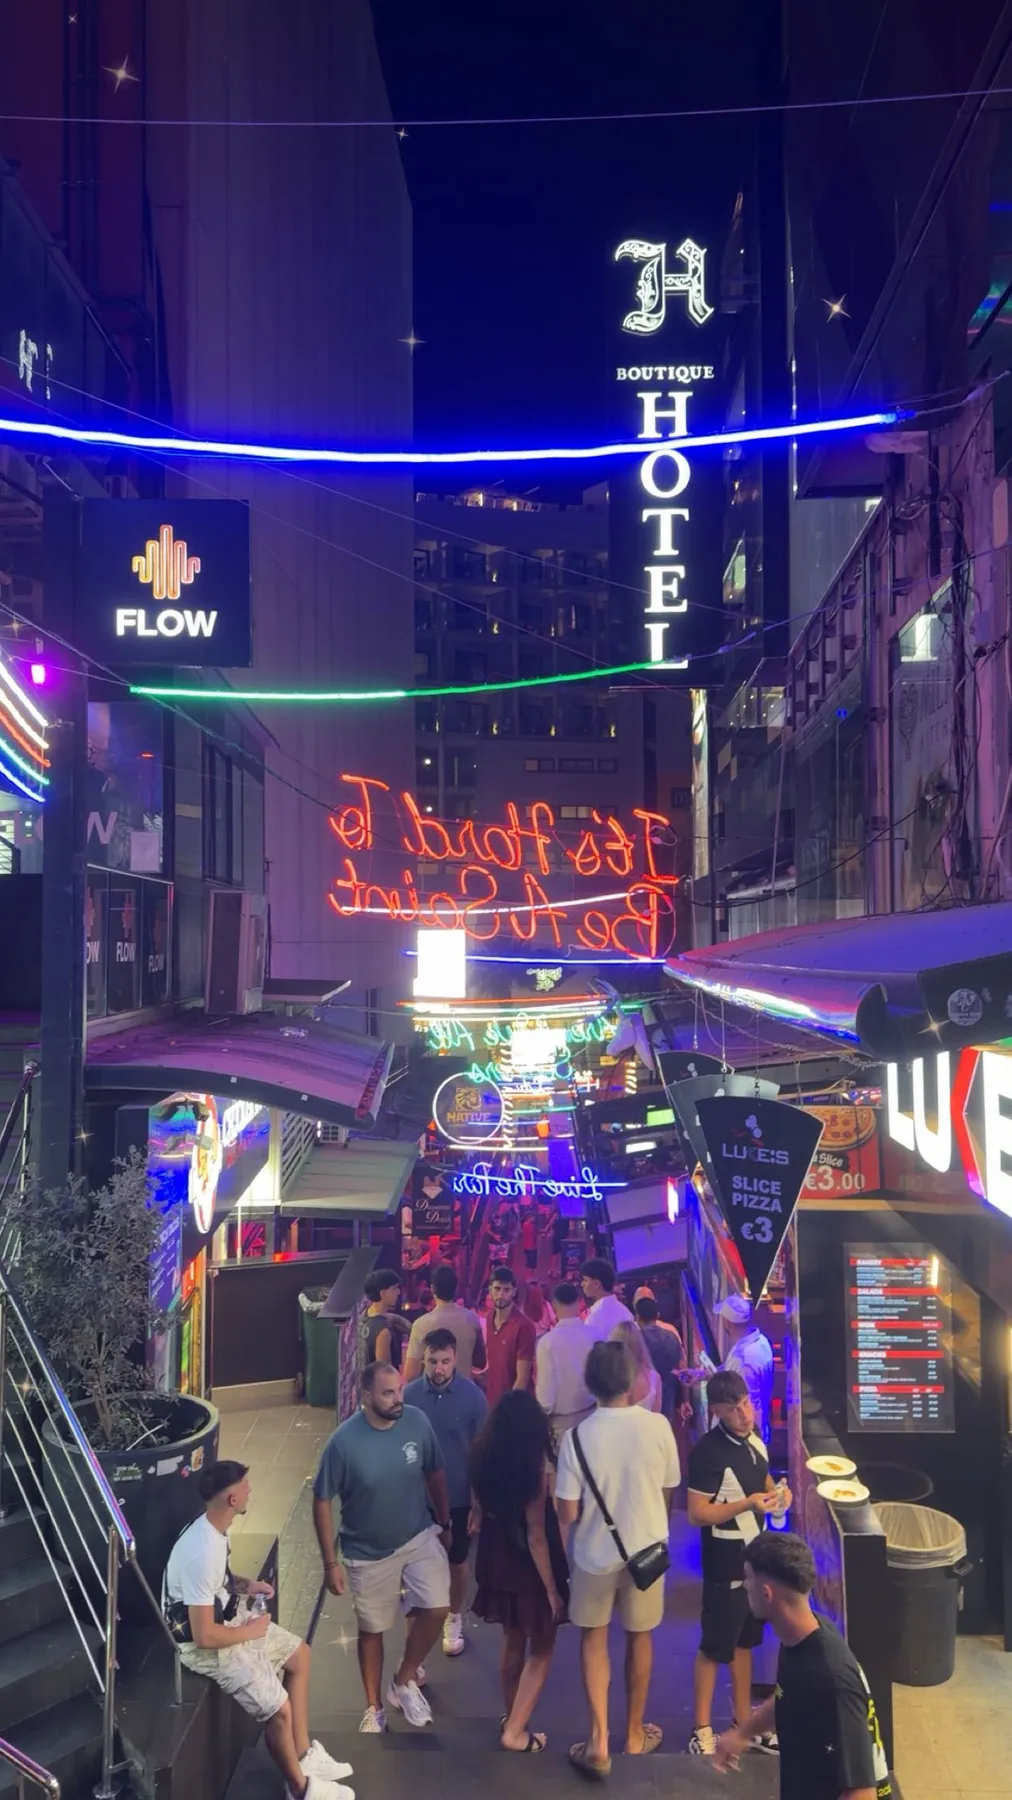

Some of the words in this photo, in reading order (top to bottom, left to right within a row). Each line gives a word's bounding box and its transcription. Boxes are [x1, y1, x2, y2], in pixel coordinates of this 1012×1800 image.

[616, 365, 715, 384] BOUTIQUE
[636, 391, 694, 670] HOTEL
[116, 608, 218, 637] FLOW
[116, 941, 137, 963] FLOW
[148, 953, 165, 973] FLOW
[447, 1112, 492, 1122] NATIVE
[819, 1153, 843, 1167] Slice
[732, 1175, 782, 1196] SLICE
[805, 1165, 866, 1191] €3.00
[732, 1192, 783, 1214] PIZZA
[741, 1216, 773, 1243] €3
